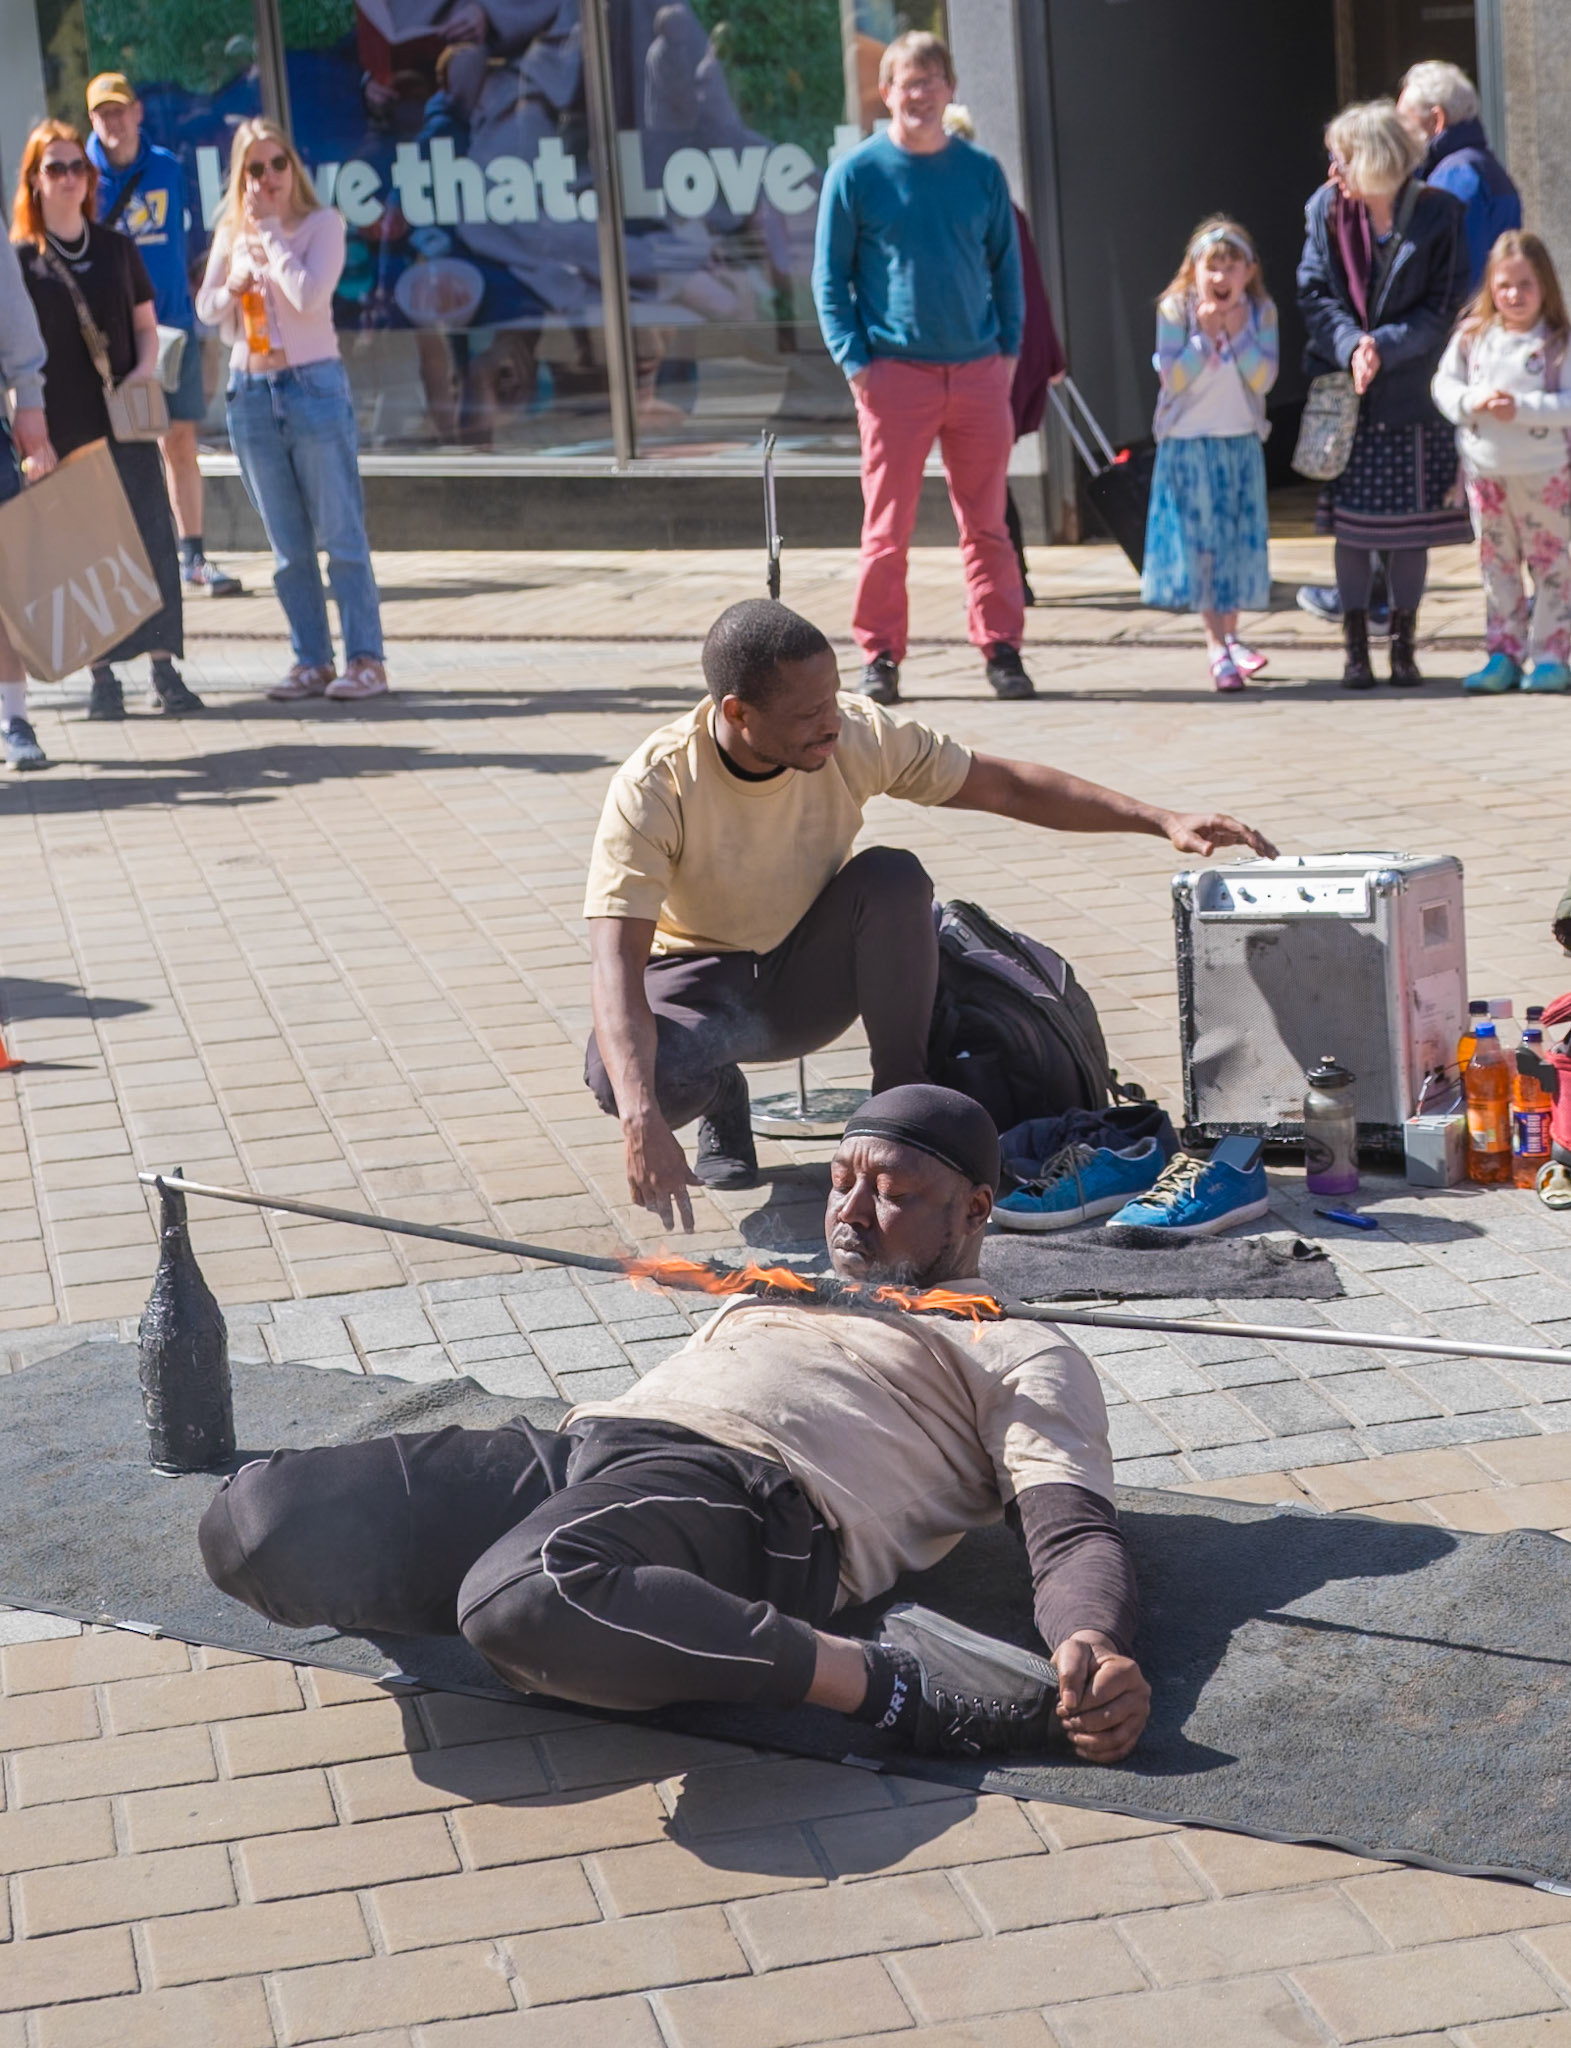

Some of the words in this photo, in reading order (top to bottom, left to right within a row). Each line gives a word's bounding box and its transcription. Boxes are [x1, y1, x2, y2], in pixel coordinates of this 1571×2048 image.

[196, 146, 384, 231] Lve
[392, 136, 598, 227] that.
[616, 131, 818, 218] Love
